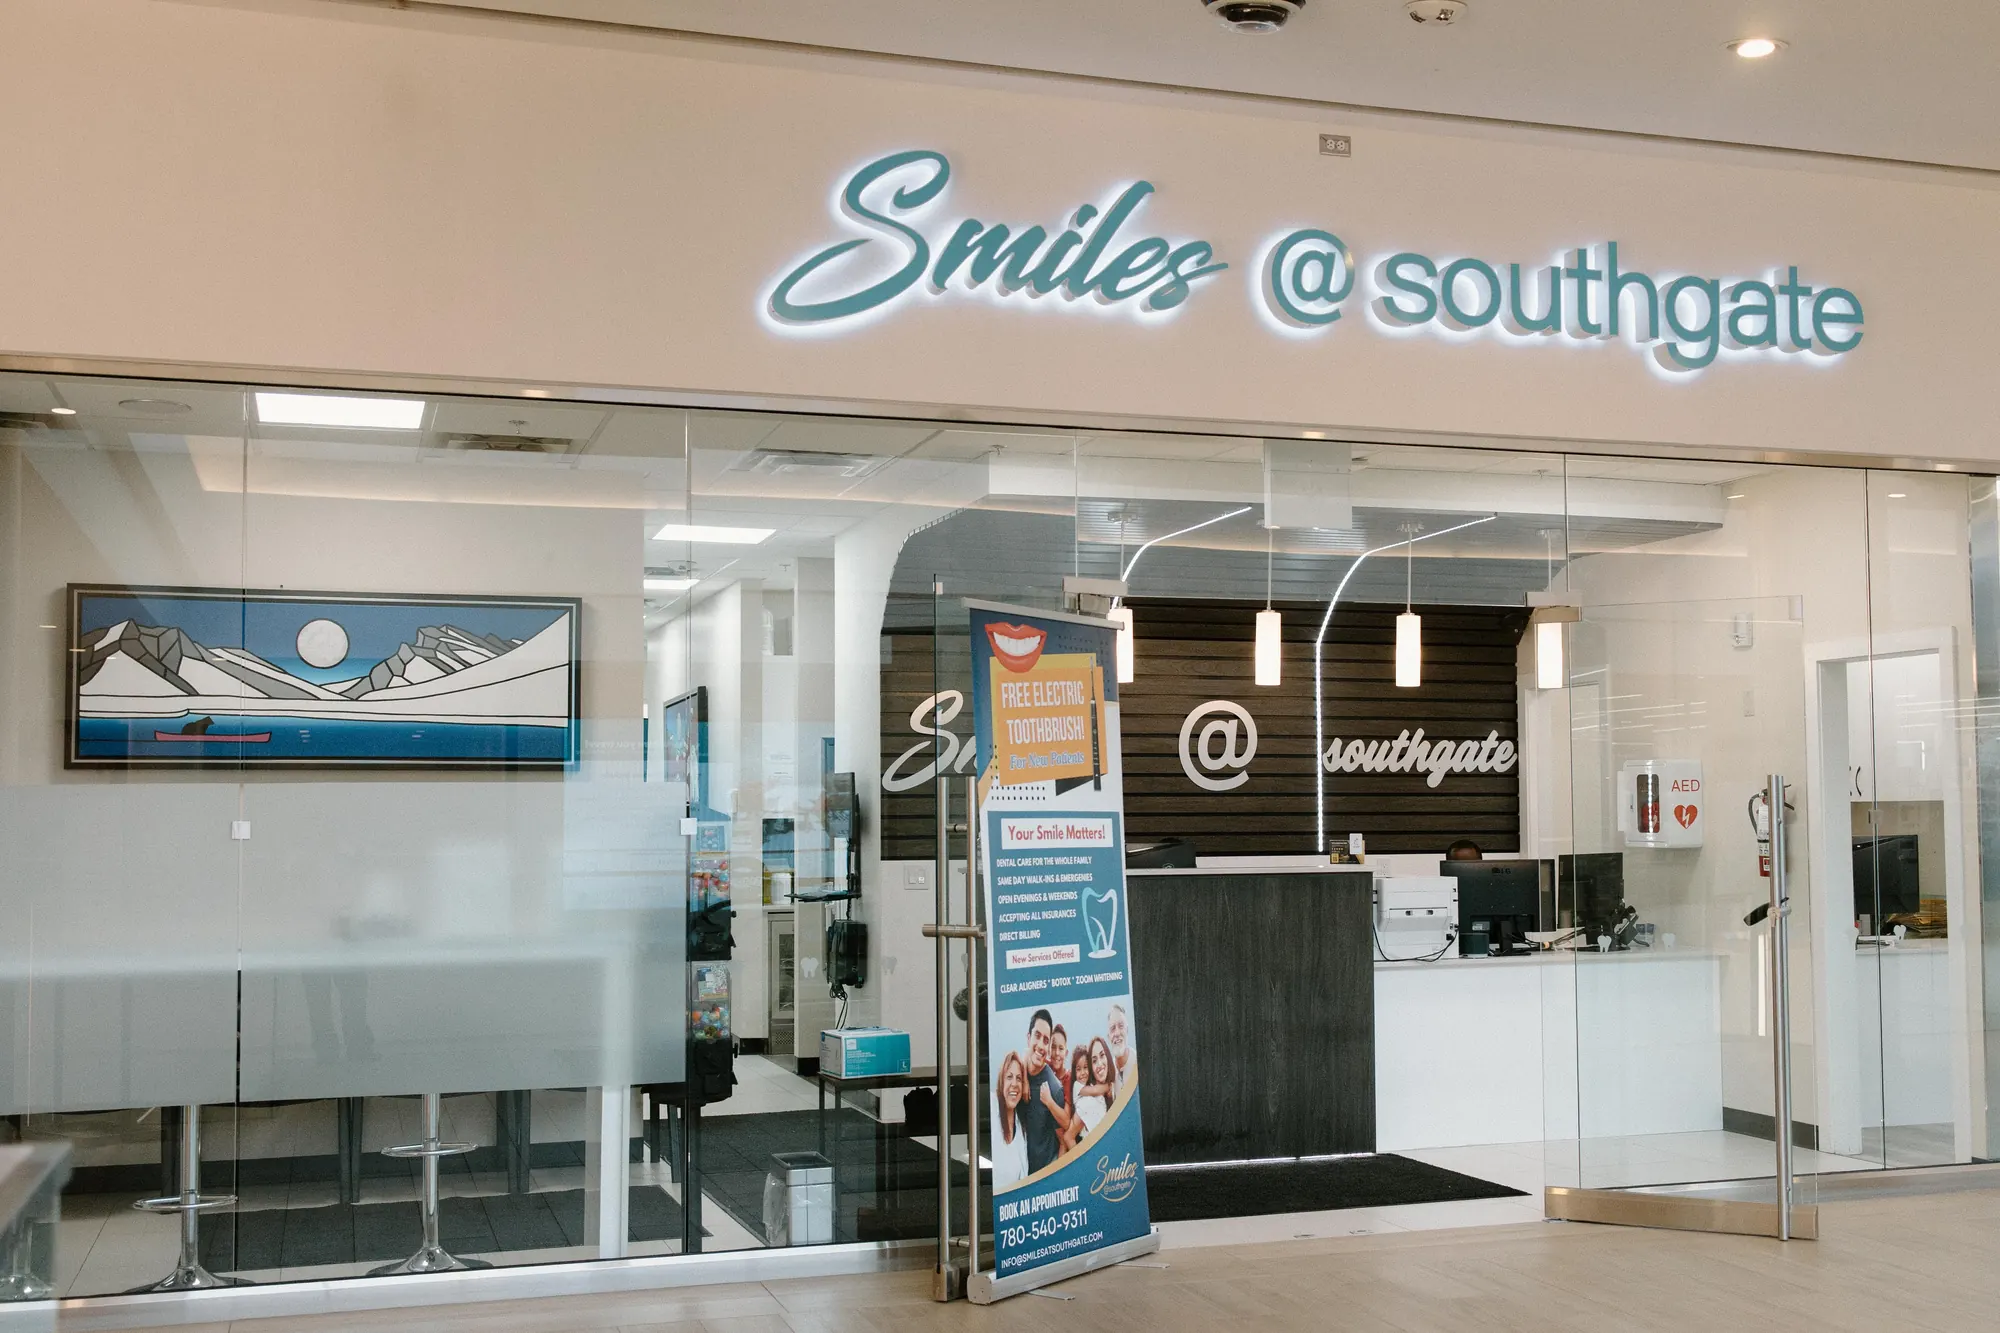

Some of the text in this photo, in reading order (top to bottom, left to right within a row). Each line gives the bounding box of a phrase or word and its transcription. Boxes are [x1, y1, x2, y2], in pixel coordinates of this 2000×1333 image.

[767, 150, 1864, 370] Smiles @ southgate
[1001, 680, 1085, 708] FREE ELECTRIC
[1006, 715, 1085, 745] TOOTHBRUSH!
[1179, 699, 1258, 792] @
[1324, 728, 1519, 789] southgate
[1009, 750, 1085, 771] For New Patients
[1671, 779, 1701, 793] AED
[1008, 824, 1106, 841] Your Smile Matters!
[996, 856, 1093, 868] DENTAL CARE FOR THE WHOLE FAMILY
[997, 876, 1013, 886] SAME
[1013, 875, 1026, 885] DAY
[1026, 874, 1055, 884] WALK-INS
[998, 895, 1013, 904] OPEN
[1013, 893, 1043, 903] EVENINGS
[1048, 891, 1078, 901] WEEKENDS
[999, 909, 1077, 923] ACCEPTING ALL INSURANCES
[999, 929, 1041, 941] DIRECT BILLING
[1012, 949, 1075, 964] New Services Offered
[1000, 971, 1123, 994] CLEAR ALIGNERS BOTOX ZOOM WHITENING
[1090, 1152, 1139, 1195] Smiles
[999, 1185, 1080, 1222] BOOK AN APPOINTMENT
[1000, 1208, 1088, 1250] 780-540-9311
[1001, 1231, 1104, 1270] INFO@SMILESATSOUTHGATE.COM
